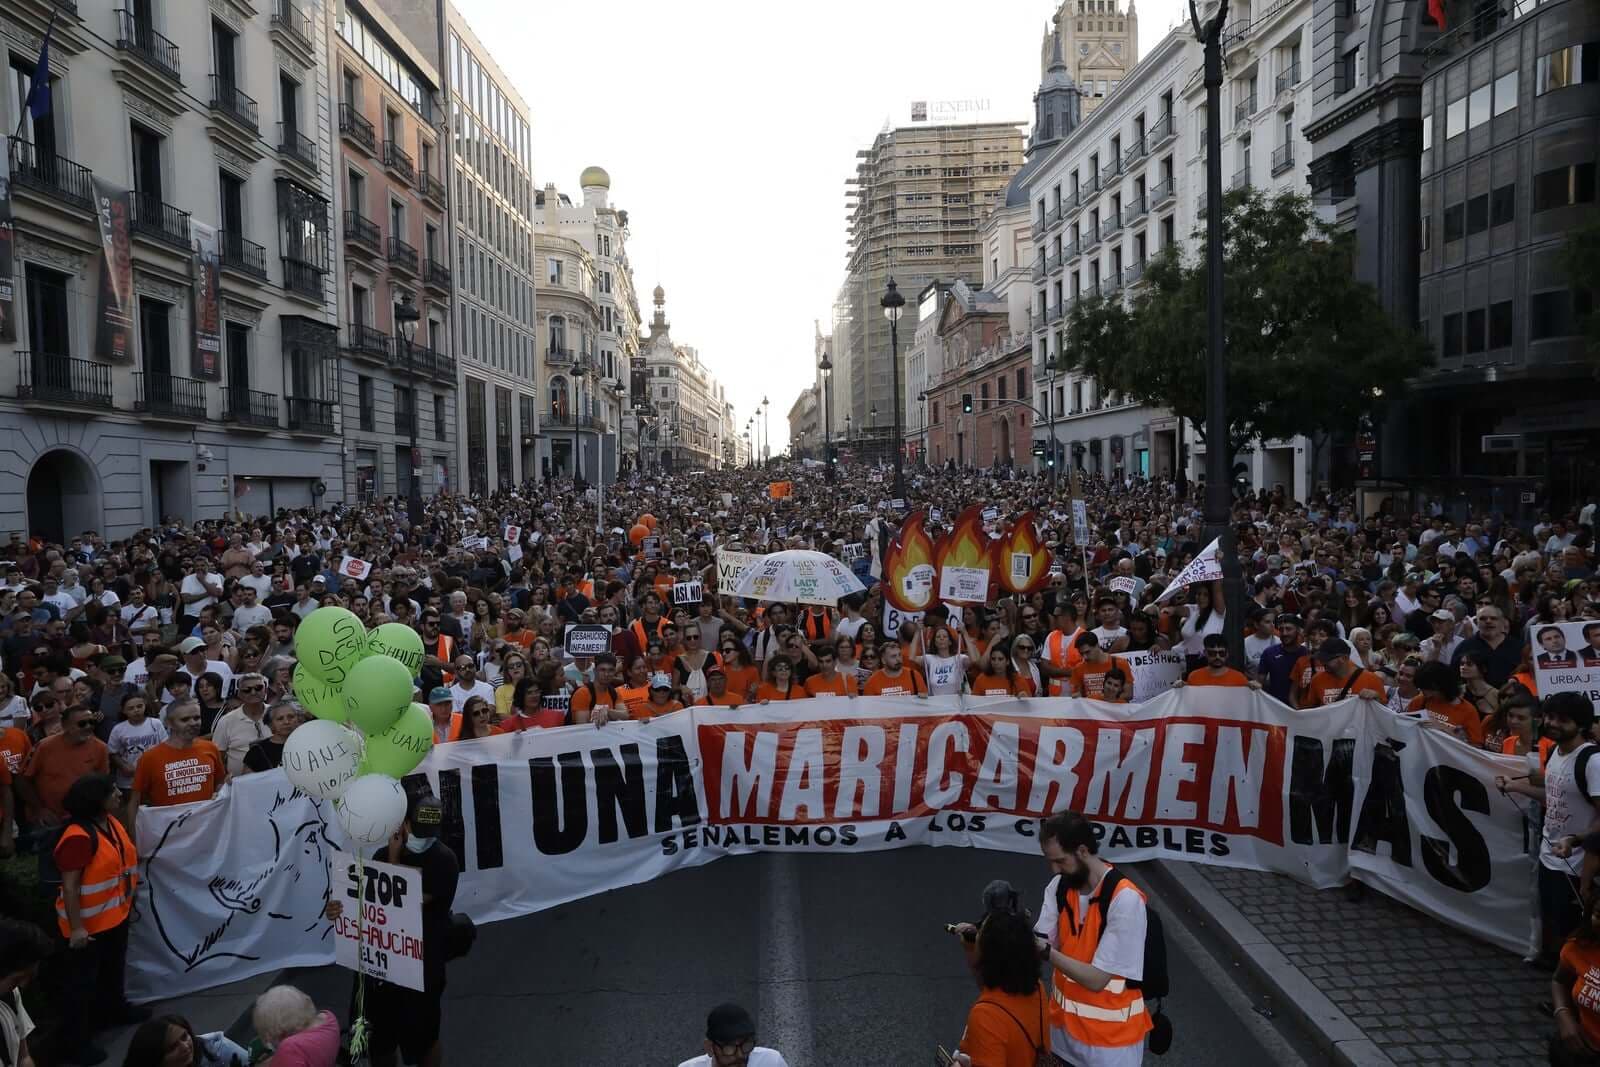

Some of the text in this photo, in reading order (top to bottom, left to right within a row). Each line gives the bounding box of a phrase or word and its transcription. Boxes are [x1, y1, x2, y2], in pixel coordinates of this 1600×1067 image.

[931, 99, 990, 113] GENERALI
[691, 585, 701, 601] NO
[572, 632, 608, 641] DESAHUCIOS
[937, 676, 949, 684] 22
[165, 759, 199, 772] SINDICATO
[168, 784, 202, 797] DE MADRID
[529, 735, 702, 855] UNA
[720, 720, 1268, 829] MARICARMEN
[1289, 735, 1491, 893] MÁS
[885, 821, 906, 842] A
[928, 813, 987, 832] LOS
[1014, 819, 1231, 857] CPABLES
[347, 863, 407, 908] STOP
[375, 951, 388, 970] 19
